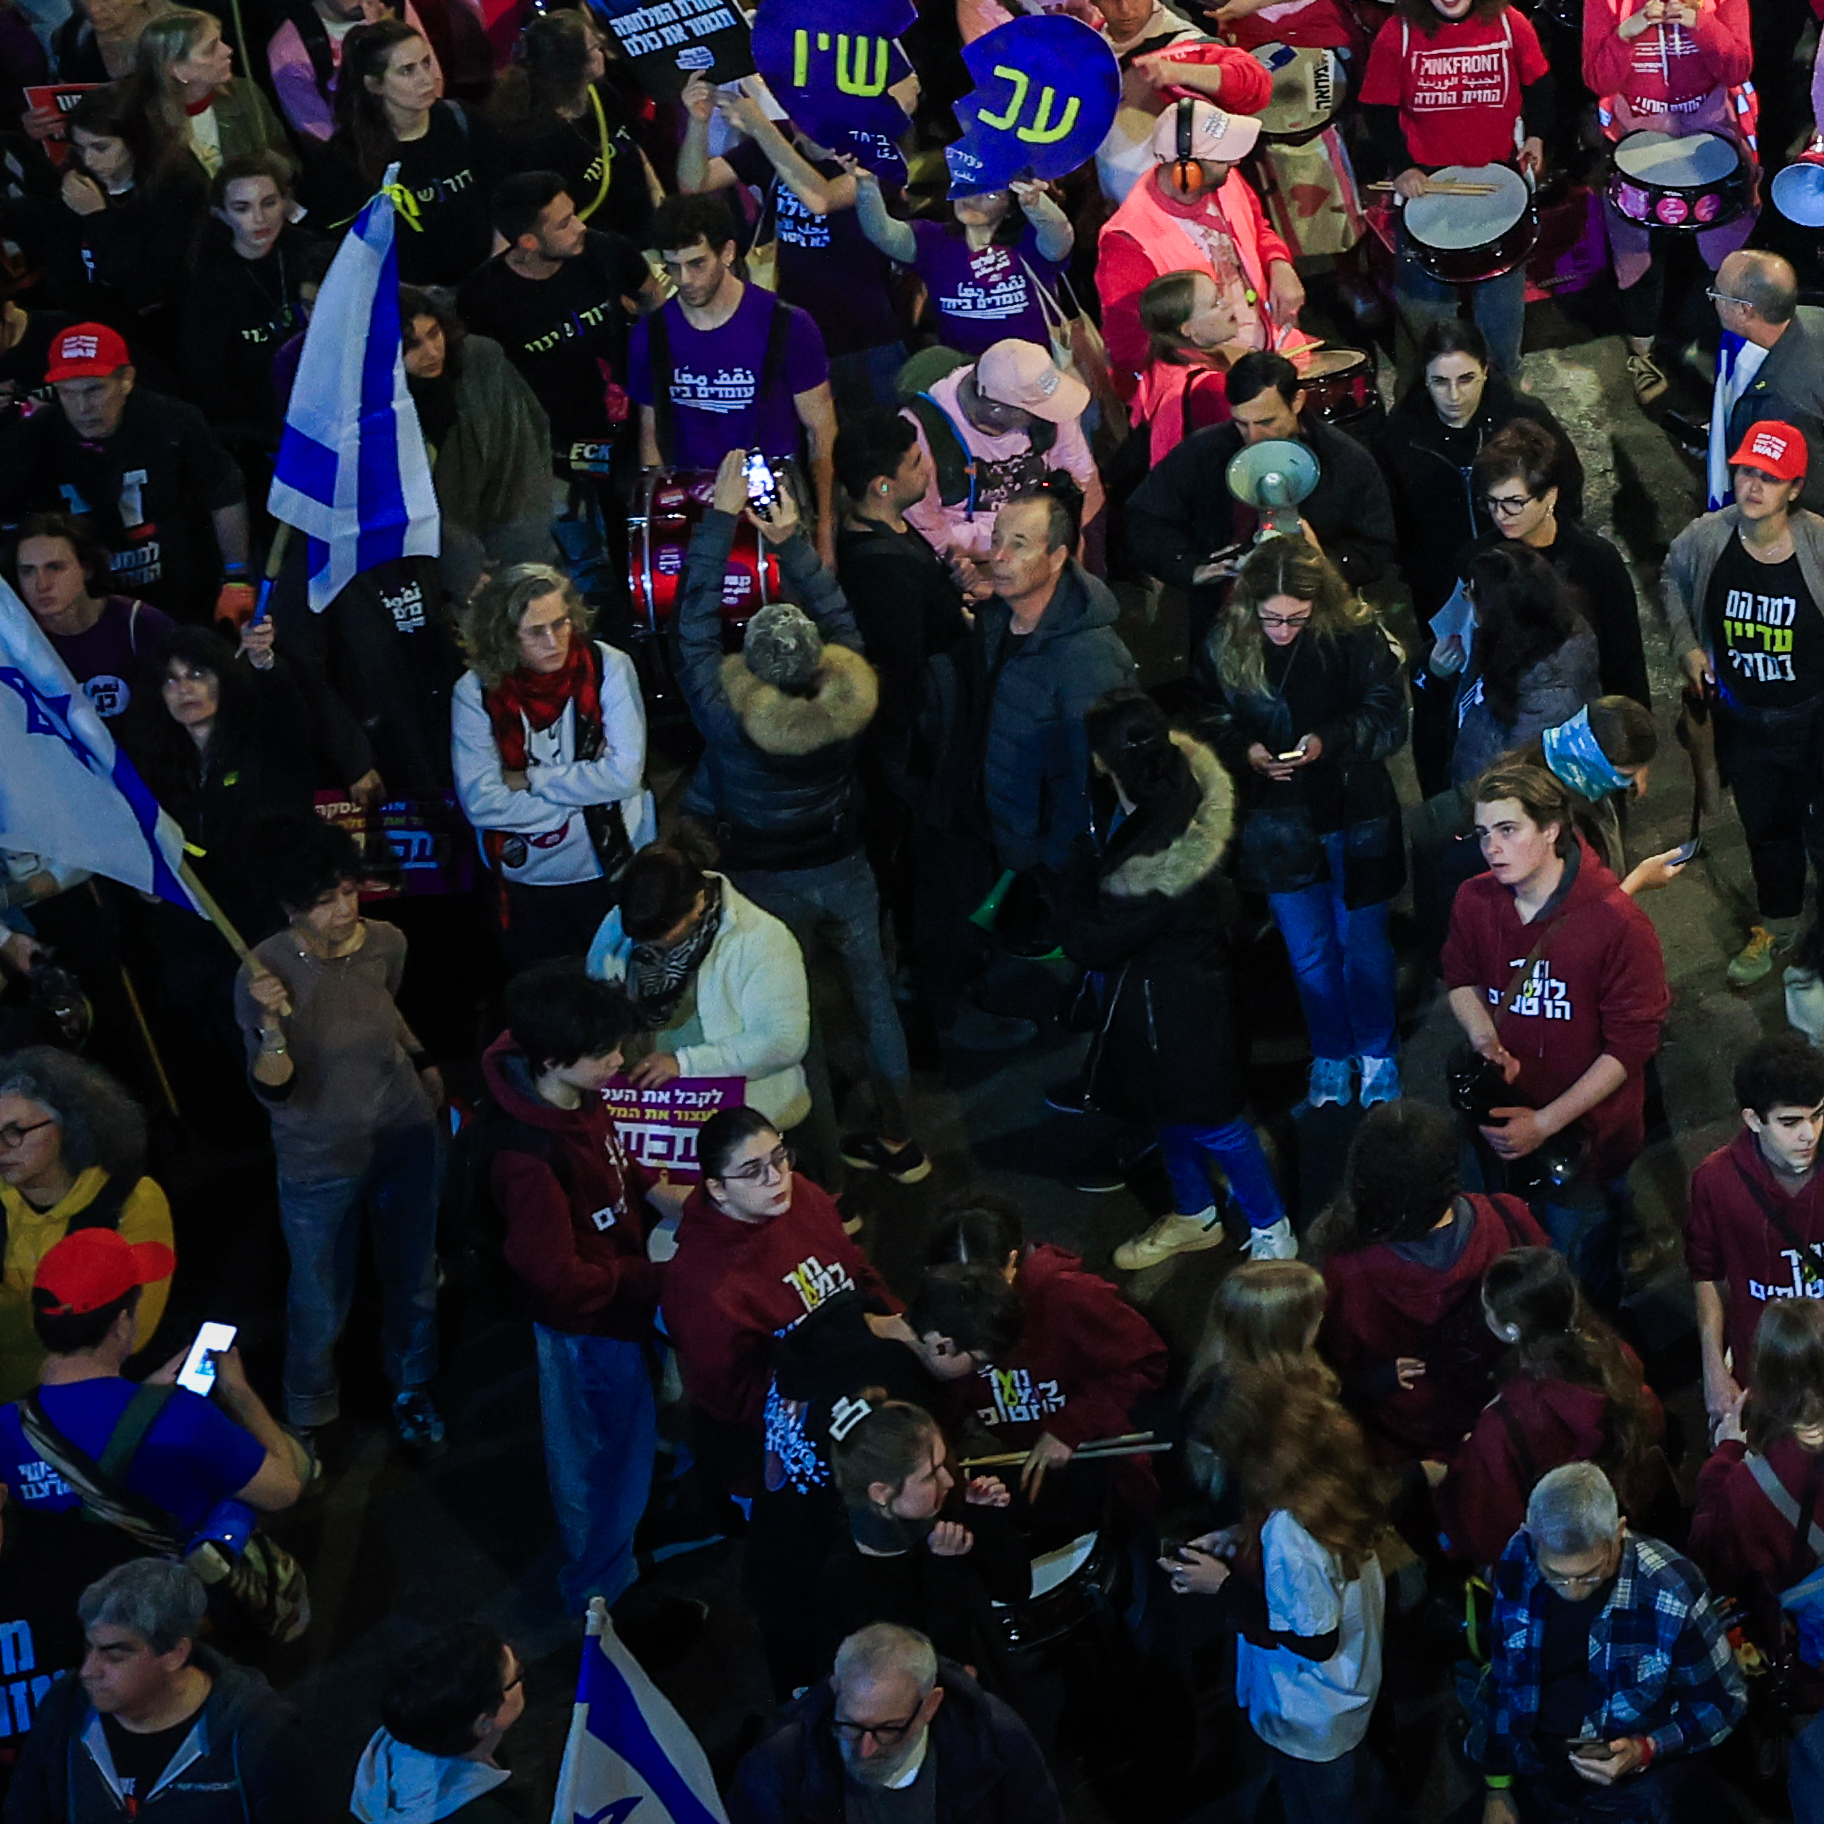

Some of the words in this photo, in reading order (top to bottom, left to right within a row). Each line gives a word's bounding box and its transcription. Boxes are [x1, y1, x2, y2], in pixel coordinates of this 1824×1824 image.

[660, 24, 689, 45] את
[1462, 88, 1500, 105] החזית
[696, 384, 756, 399] עומדים
[1725, 588, 1754, 620] הם
[1755, 594, 1796, 627] למה
[1723, 619, 1794, 652] עדיין
[641, 1088, 669, 1104] את
[676, 1086, 724, 1104] לקבל
[644, 1107, 670, 1122] את
